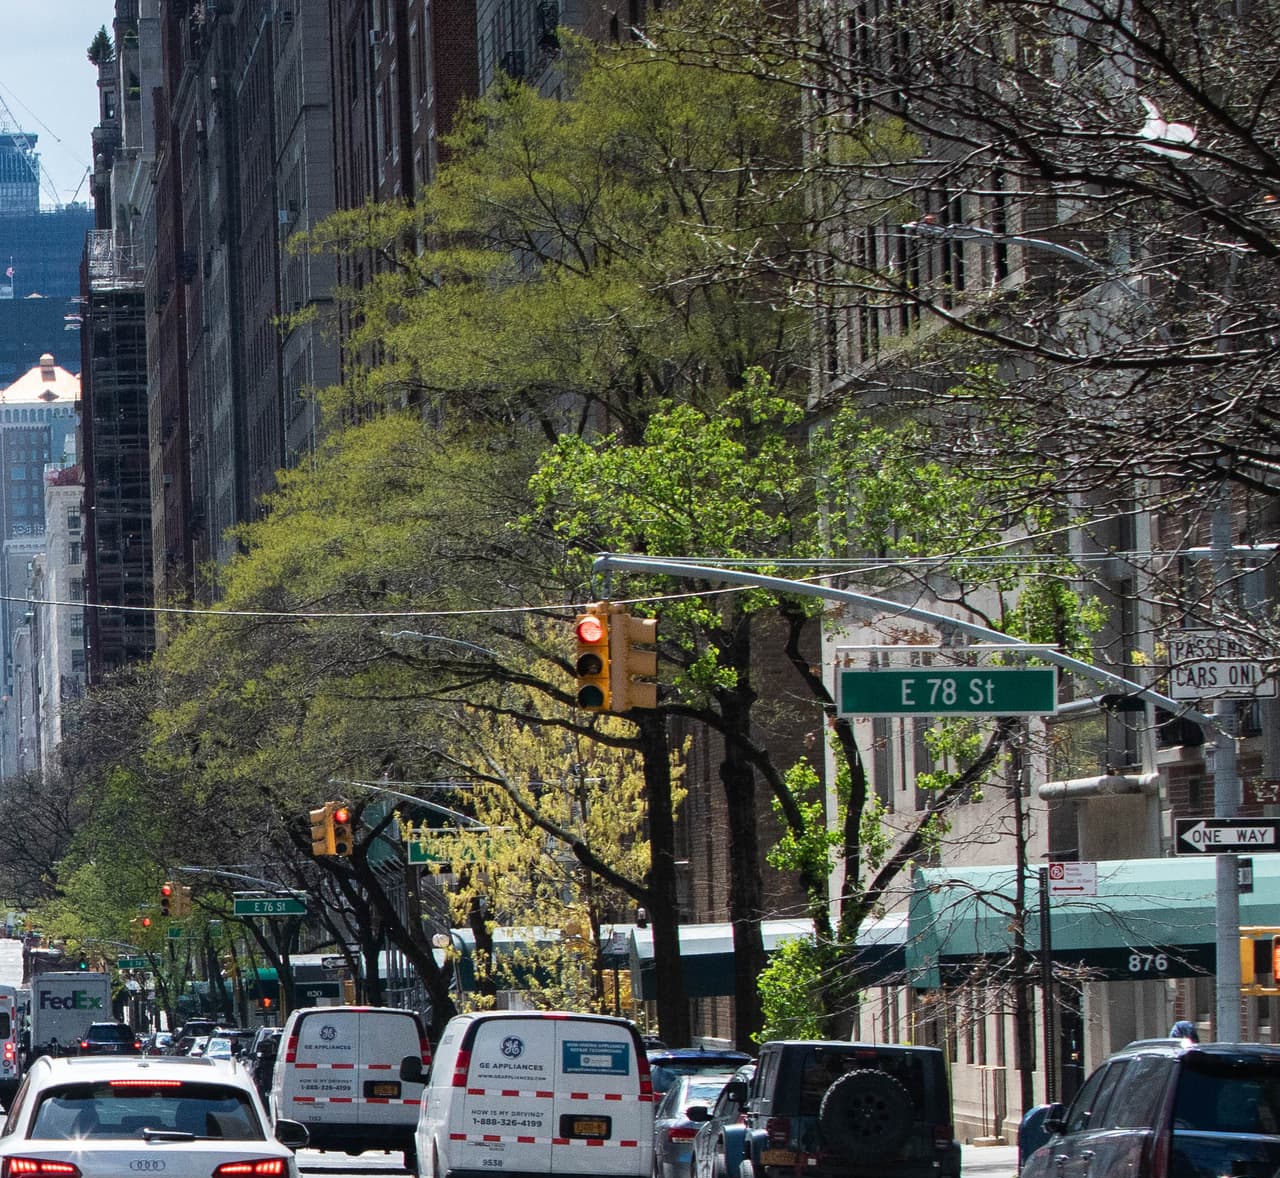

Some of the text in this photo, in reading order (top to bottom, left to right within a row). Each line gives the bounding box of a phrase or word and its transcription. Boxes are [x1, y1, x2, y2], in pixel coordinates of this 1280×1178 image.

[1176, 665, 1217, 686] CARS
[900, 678, 995, 705] E 78 St
[1192, 829, 1268, 843] ONE WAY
[254, 901, 286, 912] E 76 St
[1128, 953, 1168, 972] 876
[40, 990, 103, 1010] FedEx
[492, 1063, 544, 1071] APPLIANCES
[472, 1117, 543, 1128] 1-888-326-4199
